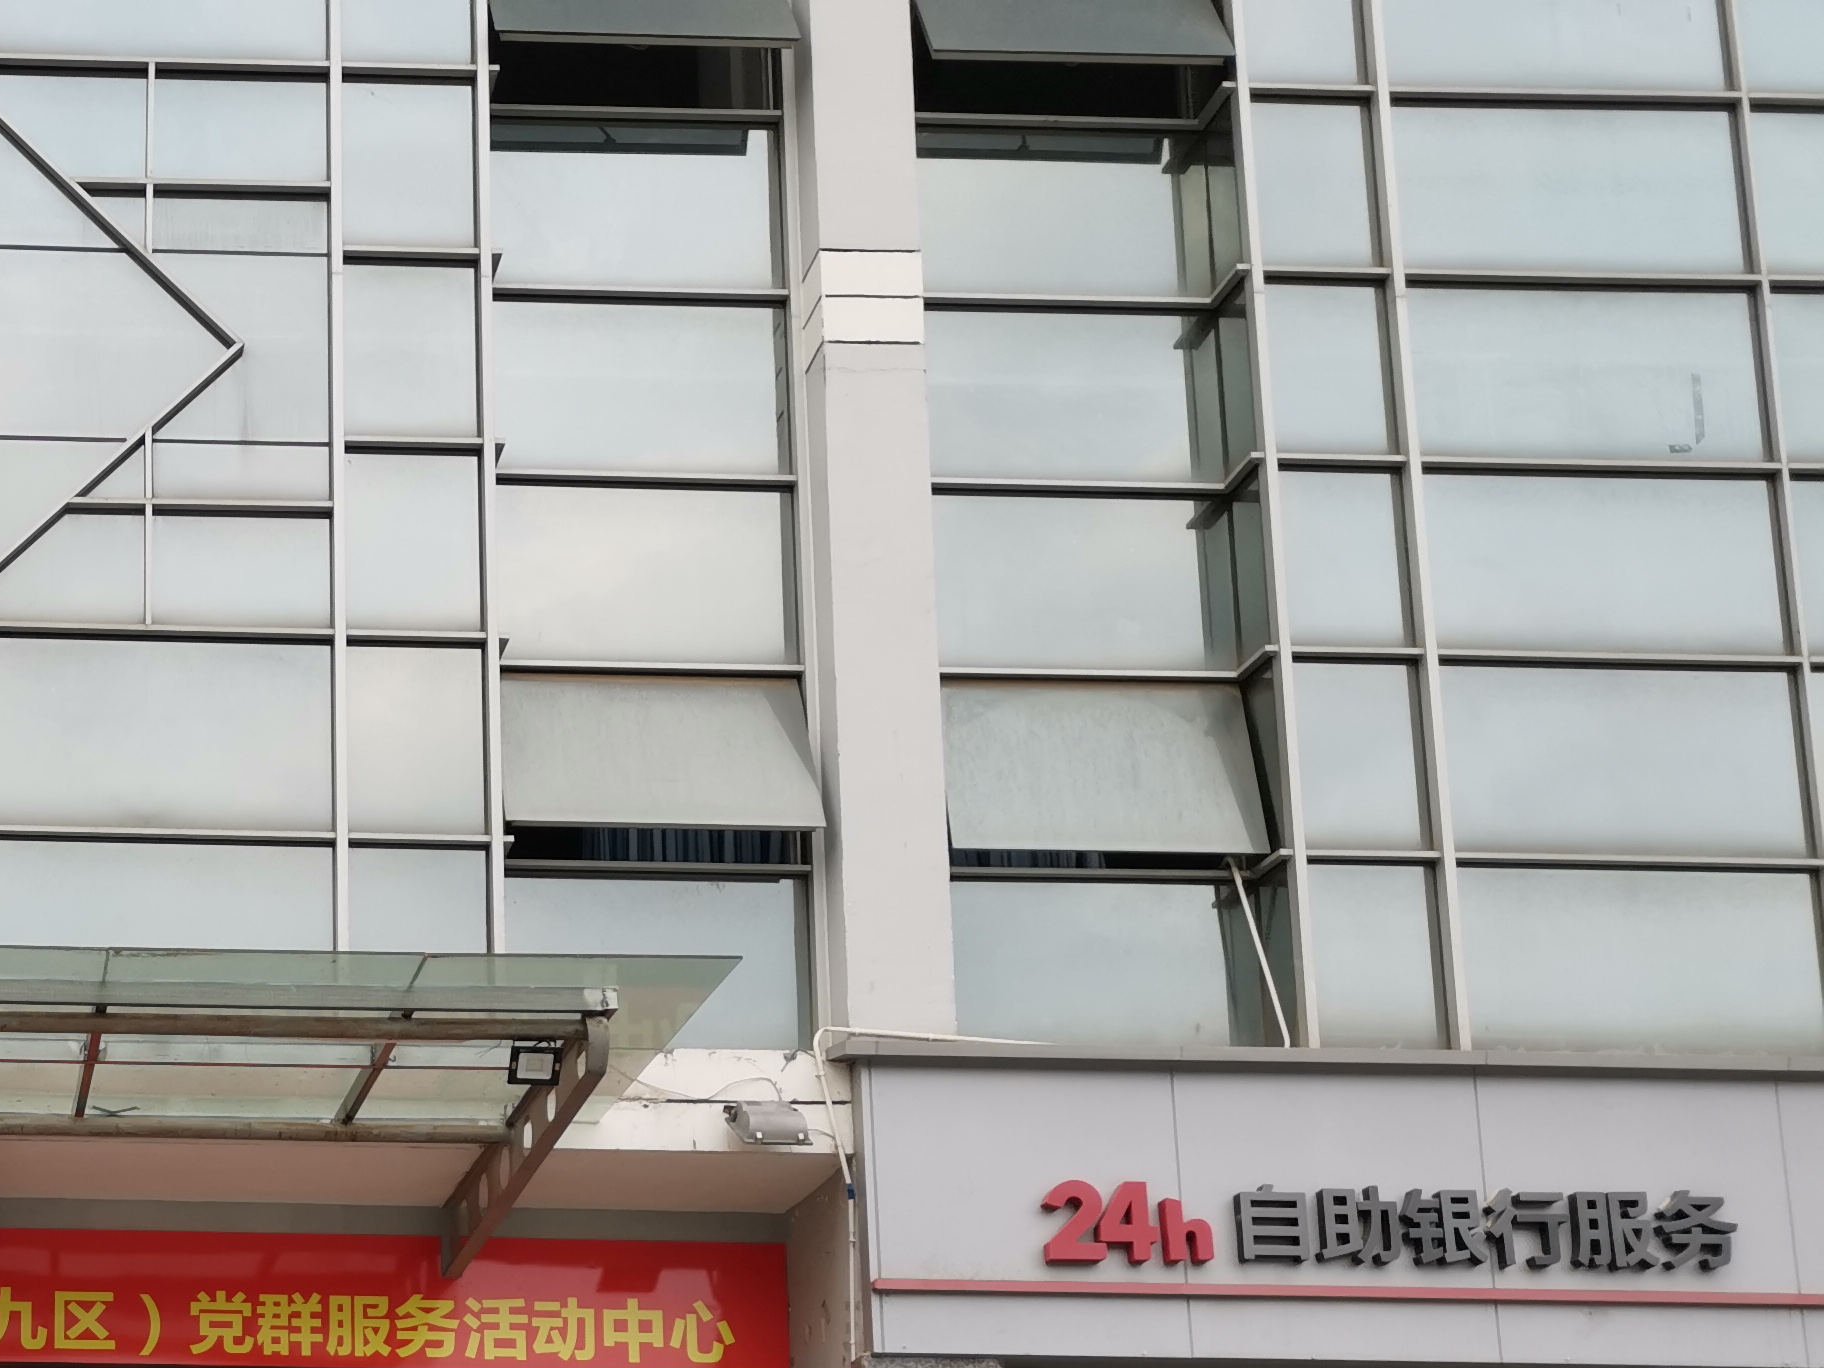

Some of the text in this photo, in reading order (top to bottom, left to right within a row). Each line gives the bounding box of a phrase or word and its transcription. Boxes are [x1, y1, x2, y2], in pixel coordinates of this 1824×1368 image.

[1040, 1179, 1739, 1274] 24h 自助银行服务
